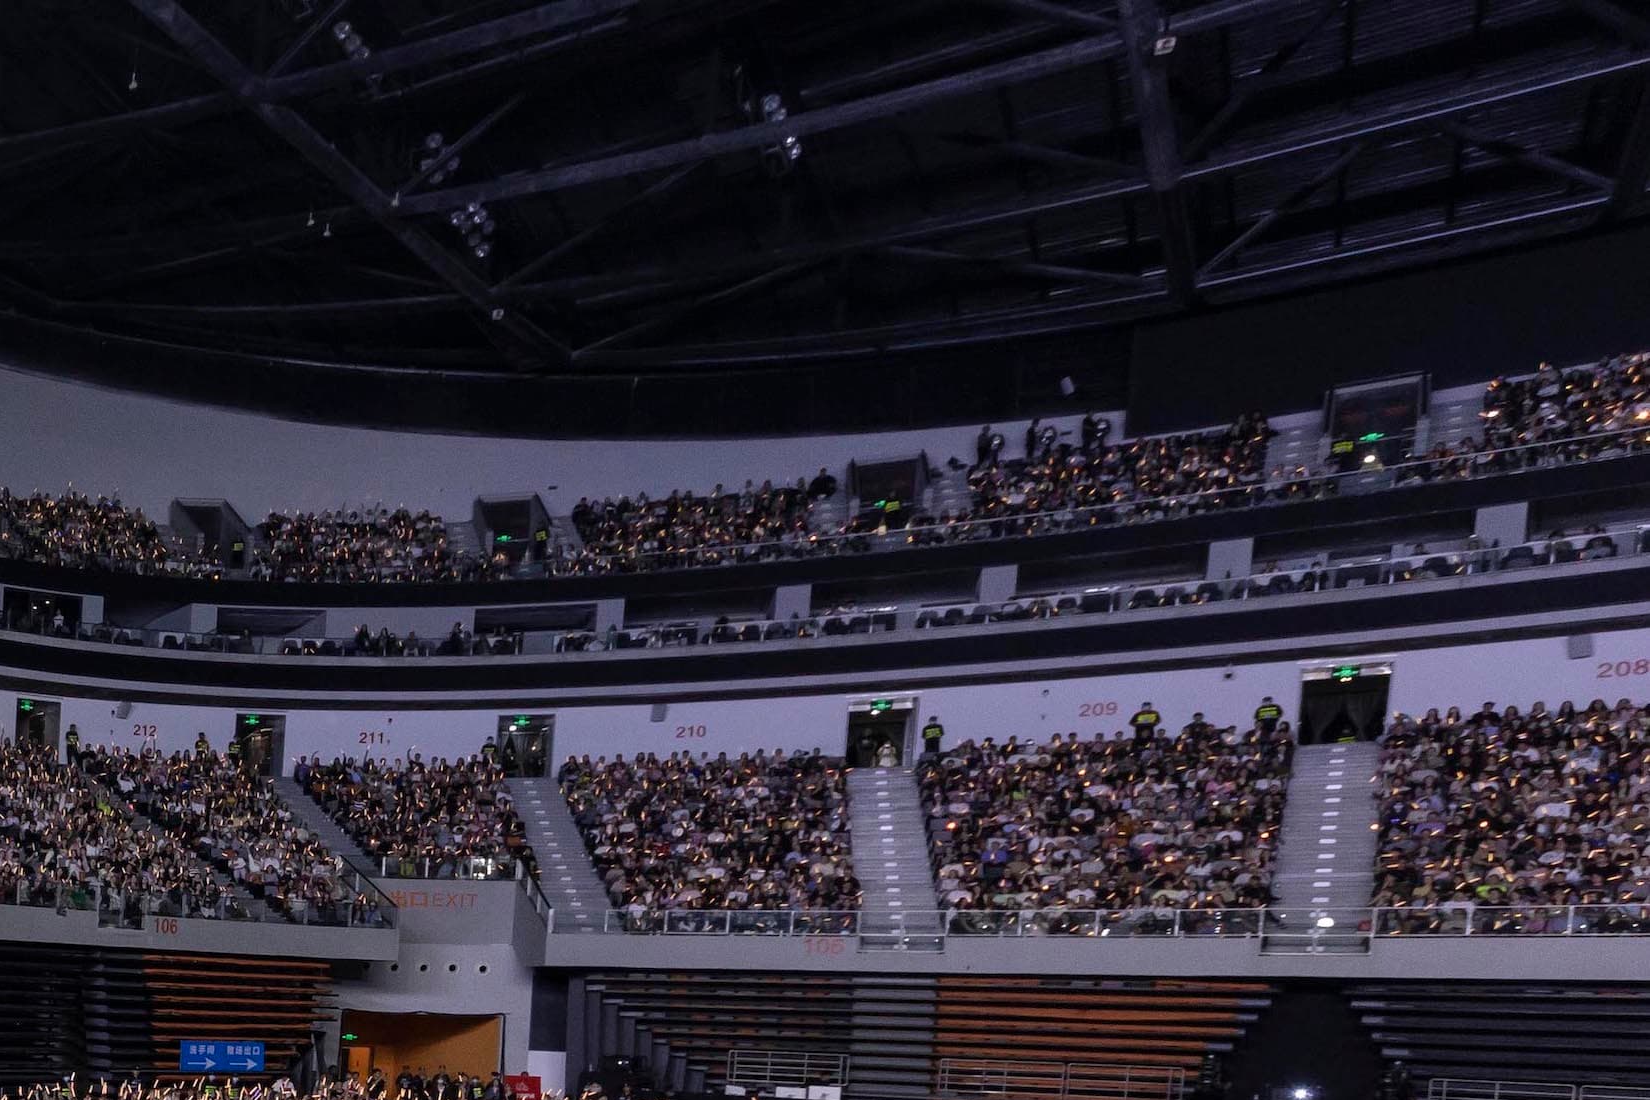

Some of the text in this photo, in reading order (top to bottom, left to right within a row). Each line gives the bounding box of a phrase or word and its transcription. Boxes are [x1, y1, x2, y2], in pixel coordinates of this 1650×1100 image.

[1597, 659, 1649, 678] 208
[1079, 702, 1118, 717] 209
[133, 724, 157, 737] 212
[359, 732, 383, 744] 211
[676, 725, 706, 738] 210
[433, 892, 478, 908] EXIT
[155, 918, 178, 934] 106
